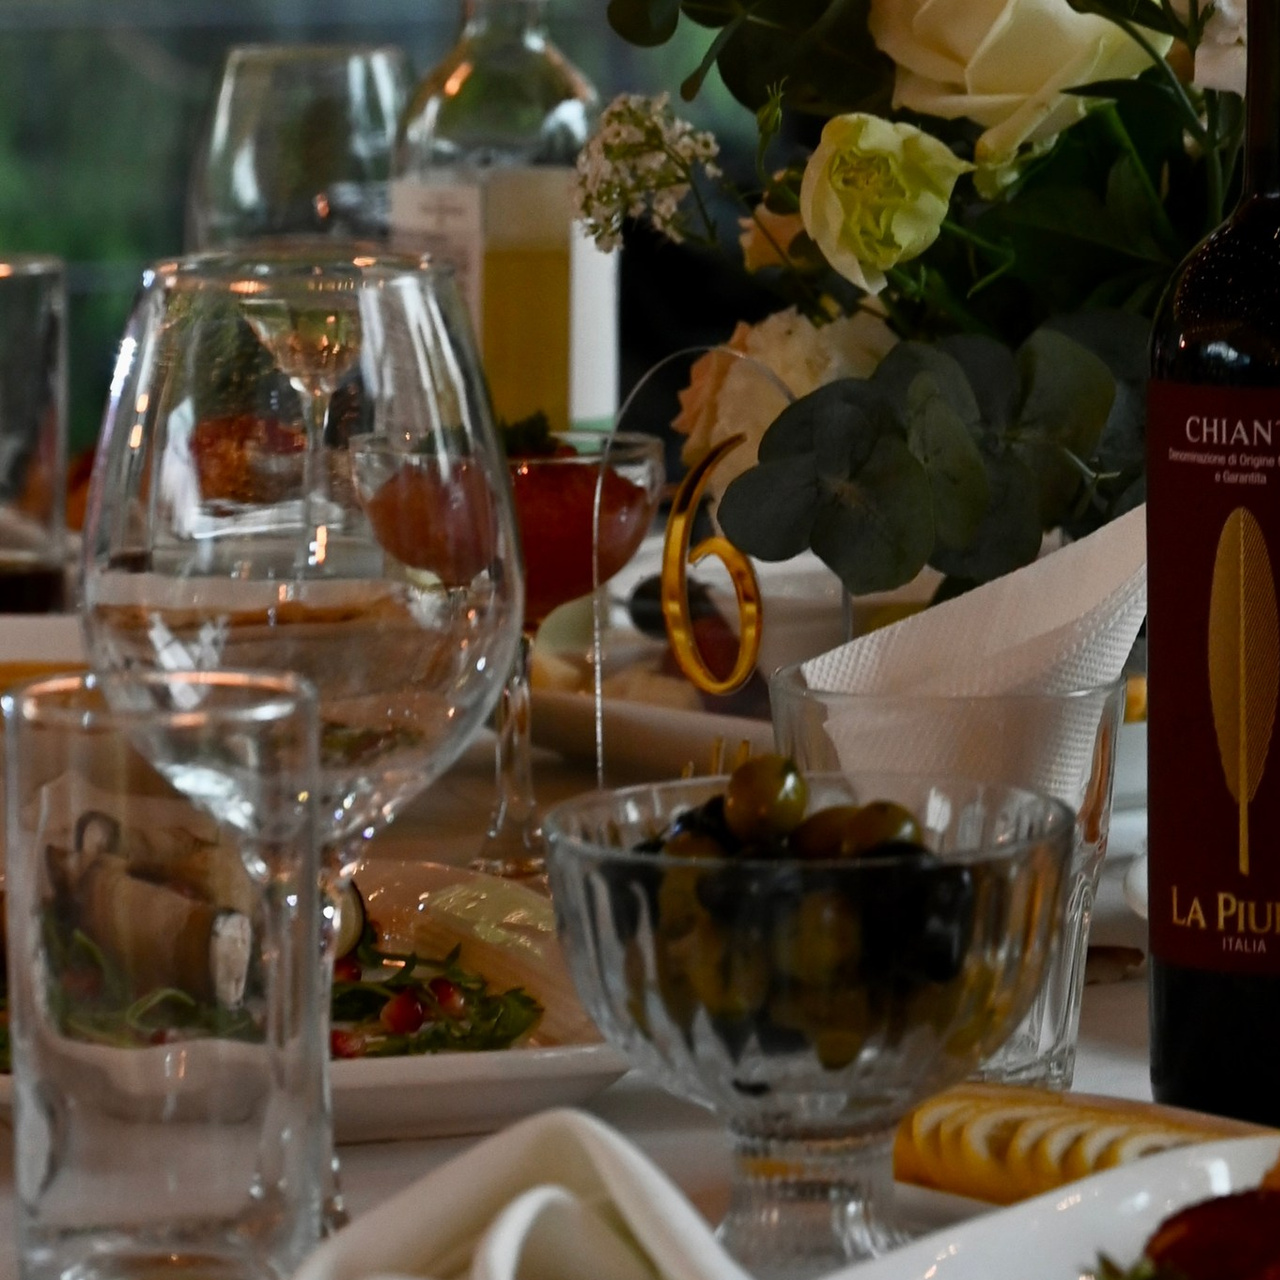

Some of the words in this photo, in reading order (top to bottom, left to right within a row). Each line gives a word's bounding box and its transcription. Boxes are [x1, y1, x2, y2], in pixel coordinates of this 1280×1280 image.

[1168, 447, 1226, 466] Denominazione
[1228, 451, 1238, 466] di
[1239, 452, 1275, 469] Origine
[1214, 471, 1221, 483] e
[1222, 469, 1268, 485] Garantita
[1222, 936, 1267, 954] ITALIA
